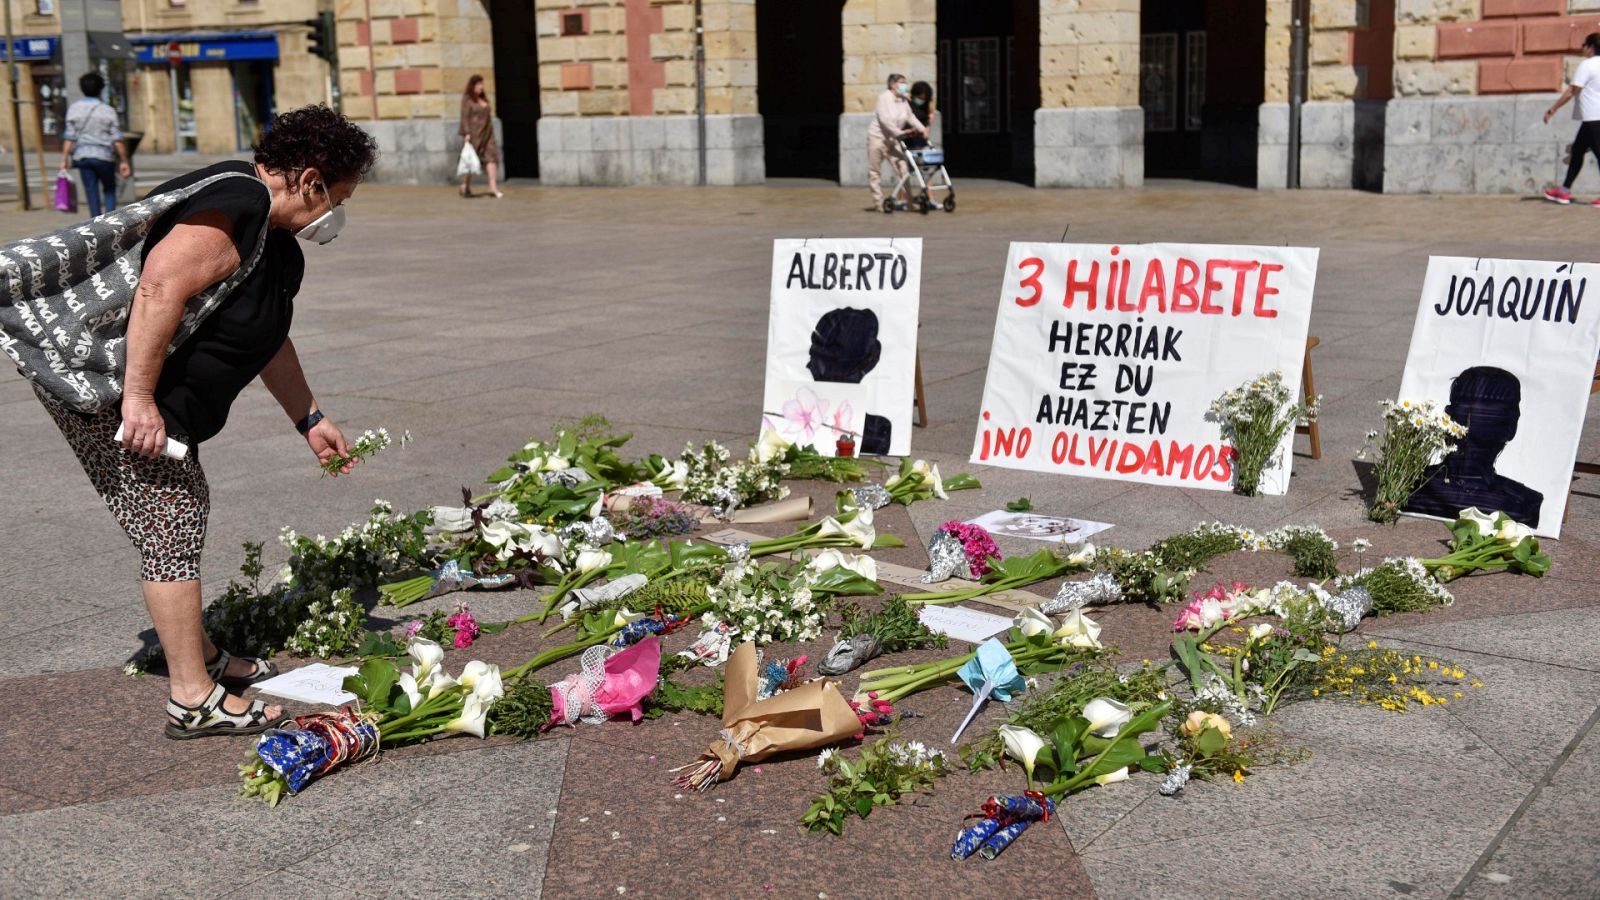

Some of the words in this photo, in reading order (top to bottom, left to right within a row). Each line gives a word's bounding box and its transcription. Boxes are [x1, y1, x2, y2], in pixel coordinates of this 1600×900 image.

[787, 253, 906, 291] ALBERTO
[1015, 257, 1045, 308] 3
[1434, 264, 1586, 325] JOAQUÍN
[1060, 362, 1096, 391] EZ
[1115, 364, 1153, 396] DU
[1036, 395, 1172, 435] AHAZTEN
[1051, 432, 1238, 483] OLVIDAMOS
